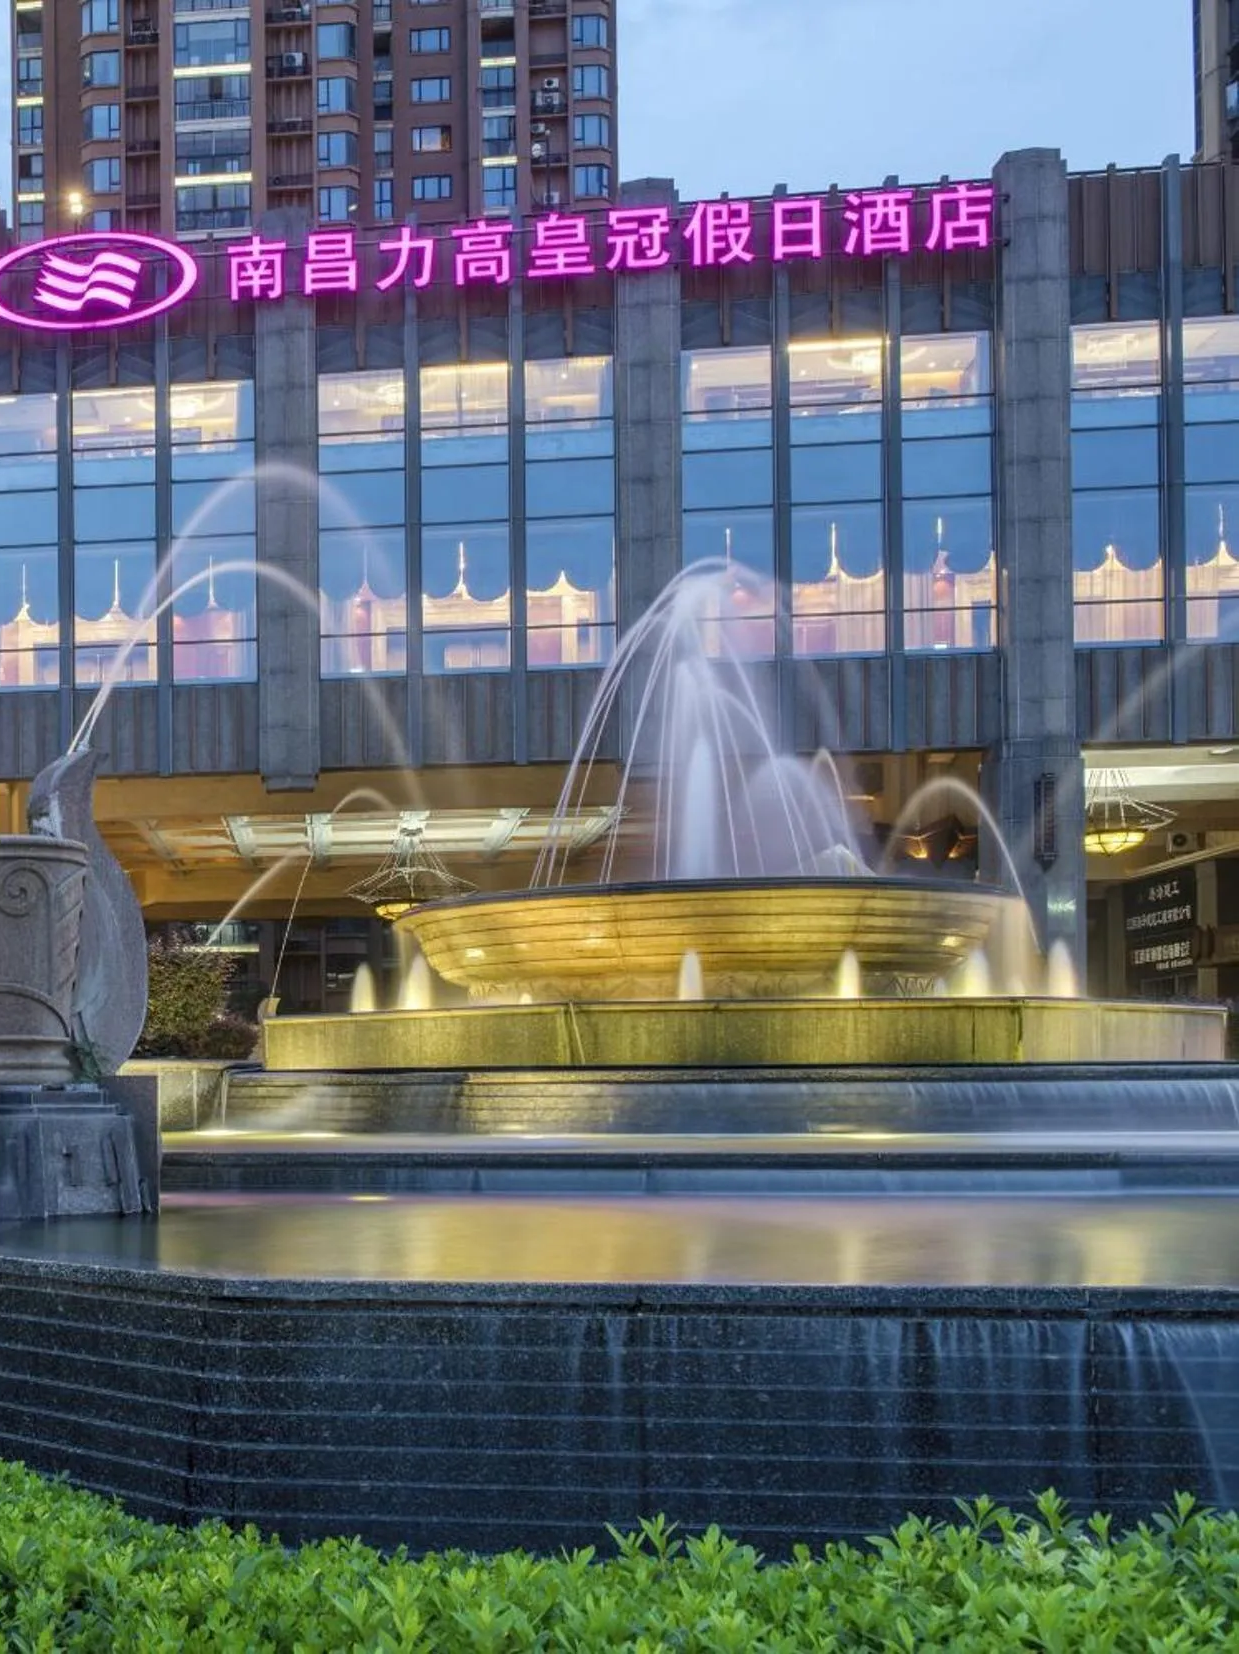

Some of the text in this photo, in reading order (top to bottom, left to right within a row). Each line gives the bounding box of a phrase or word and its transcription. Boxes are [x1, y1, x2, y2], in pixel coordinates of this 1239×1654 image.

[226, 185, 994, 301] 南昌力高皇冠假日酒店
